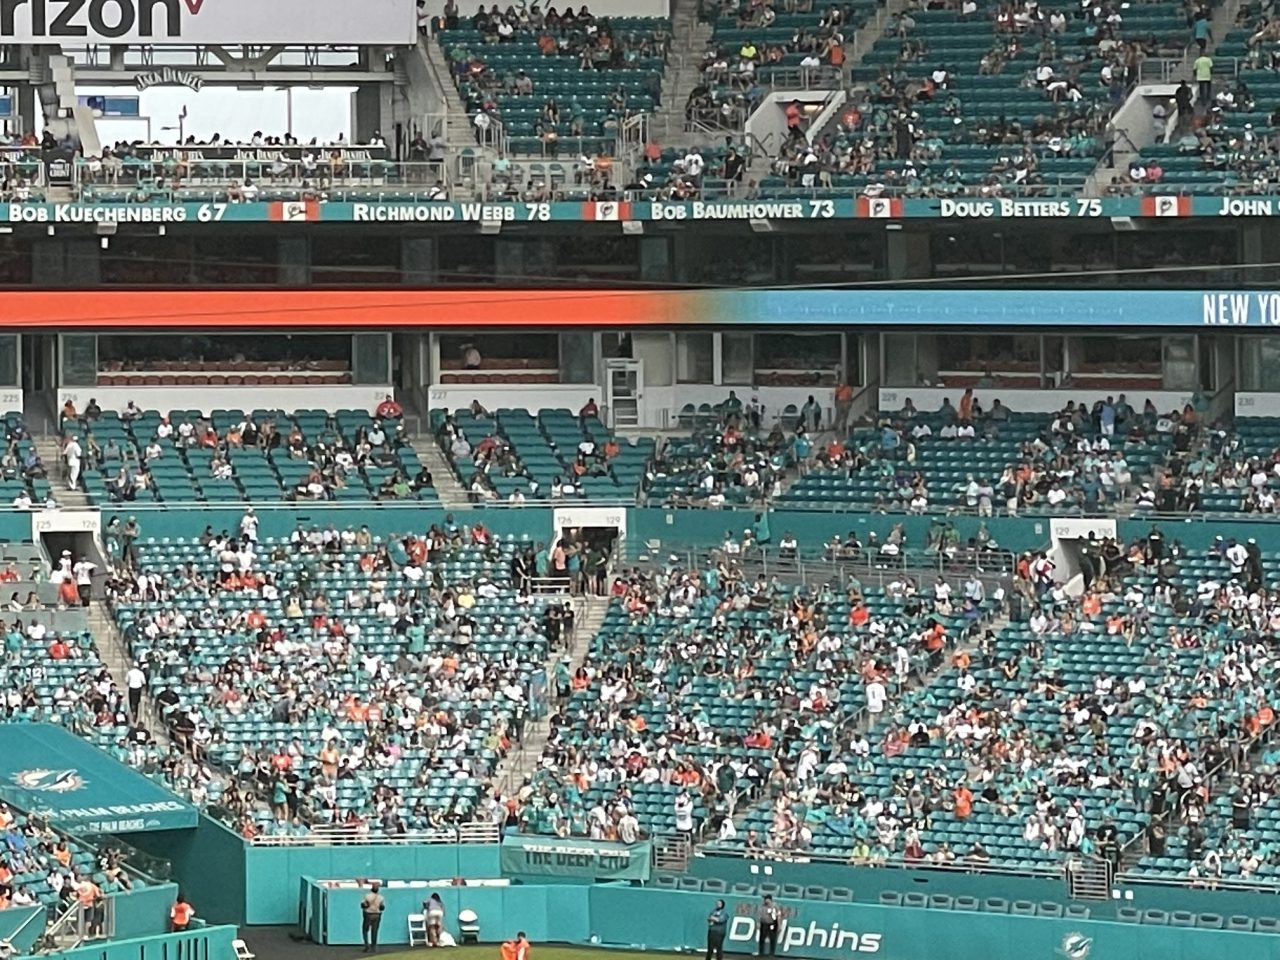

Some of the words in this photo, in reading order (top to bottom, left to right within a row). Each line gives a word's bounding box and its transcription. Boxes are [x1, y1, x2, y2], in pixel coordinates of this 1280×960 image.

[134, 72, 162, 92] JACK
[9, 203, 49, 222] BOB
[54, 204, 187, 222] KUECHENBERG
[197, 203, 227, 222] 67
[353, 203, 455, 221] RICHMOND
[460, 203, 515, 221] WEBB
[525, 203, 552, 221] 78
[650, 202, 687, 220] BOB
[692, 201, 804, 219] BAUMHOWER
[809, 200, 836, 218] 73
[940, 198, 994, 217] DOUG
[1000, 198, 1071, 217] BETTERS
[1076, 198, 1102, 217] 75
[1218, 197, 1272, 217] JOHN
[1203, 293, 1249, 324] NEW
[3, 394, 20, 403] 225
[431, 391, 447, 400] 227
[82, 520, 97, 528] 126
[557, 516, 572, 524] 126
[606, 516, 621, 524] 129
[1055, 527, 1070, 536] 129
[1098, 527, 1113, 536] 130
[100, 820, 118, 832] PALM
[118, 818, 145, 831] BEACHES
[524, 844, 553, 866] THE
[556, 846, 595, 868] DEEP
[728, 915, 882, 953] Dlphins
